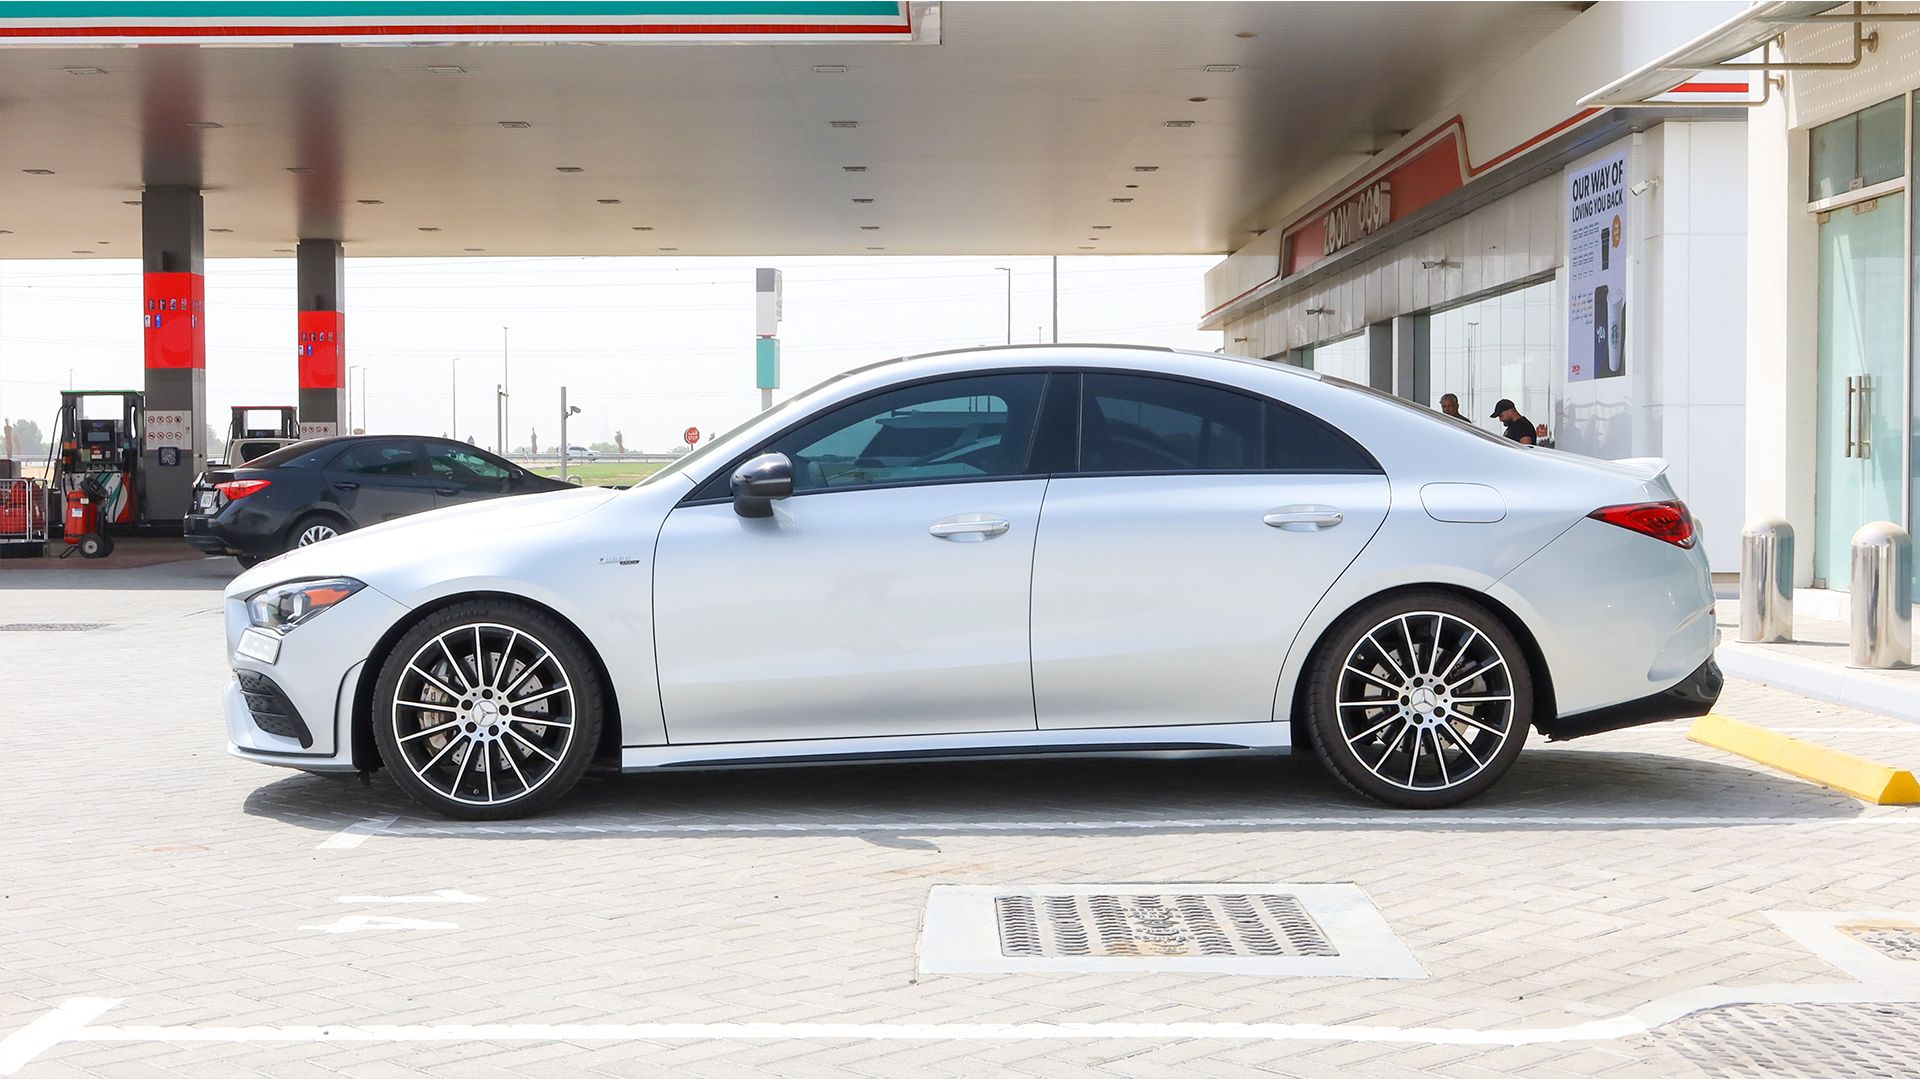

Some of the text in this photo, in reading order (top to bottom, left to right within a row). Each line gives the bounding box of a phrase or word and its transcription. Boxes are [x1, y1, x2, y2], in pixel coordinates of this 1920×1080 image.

[1572, 160, 1623, 202] OUR WAY OF
[1572, 188, 1623, 223] LOVING YOU BACK
[1324, 202, 1358, 256] ZOOM
